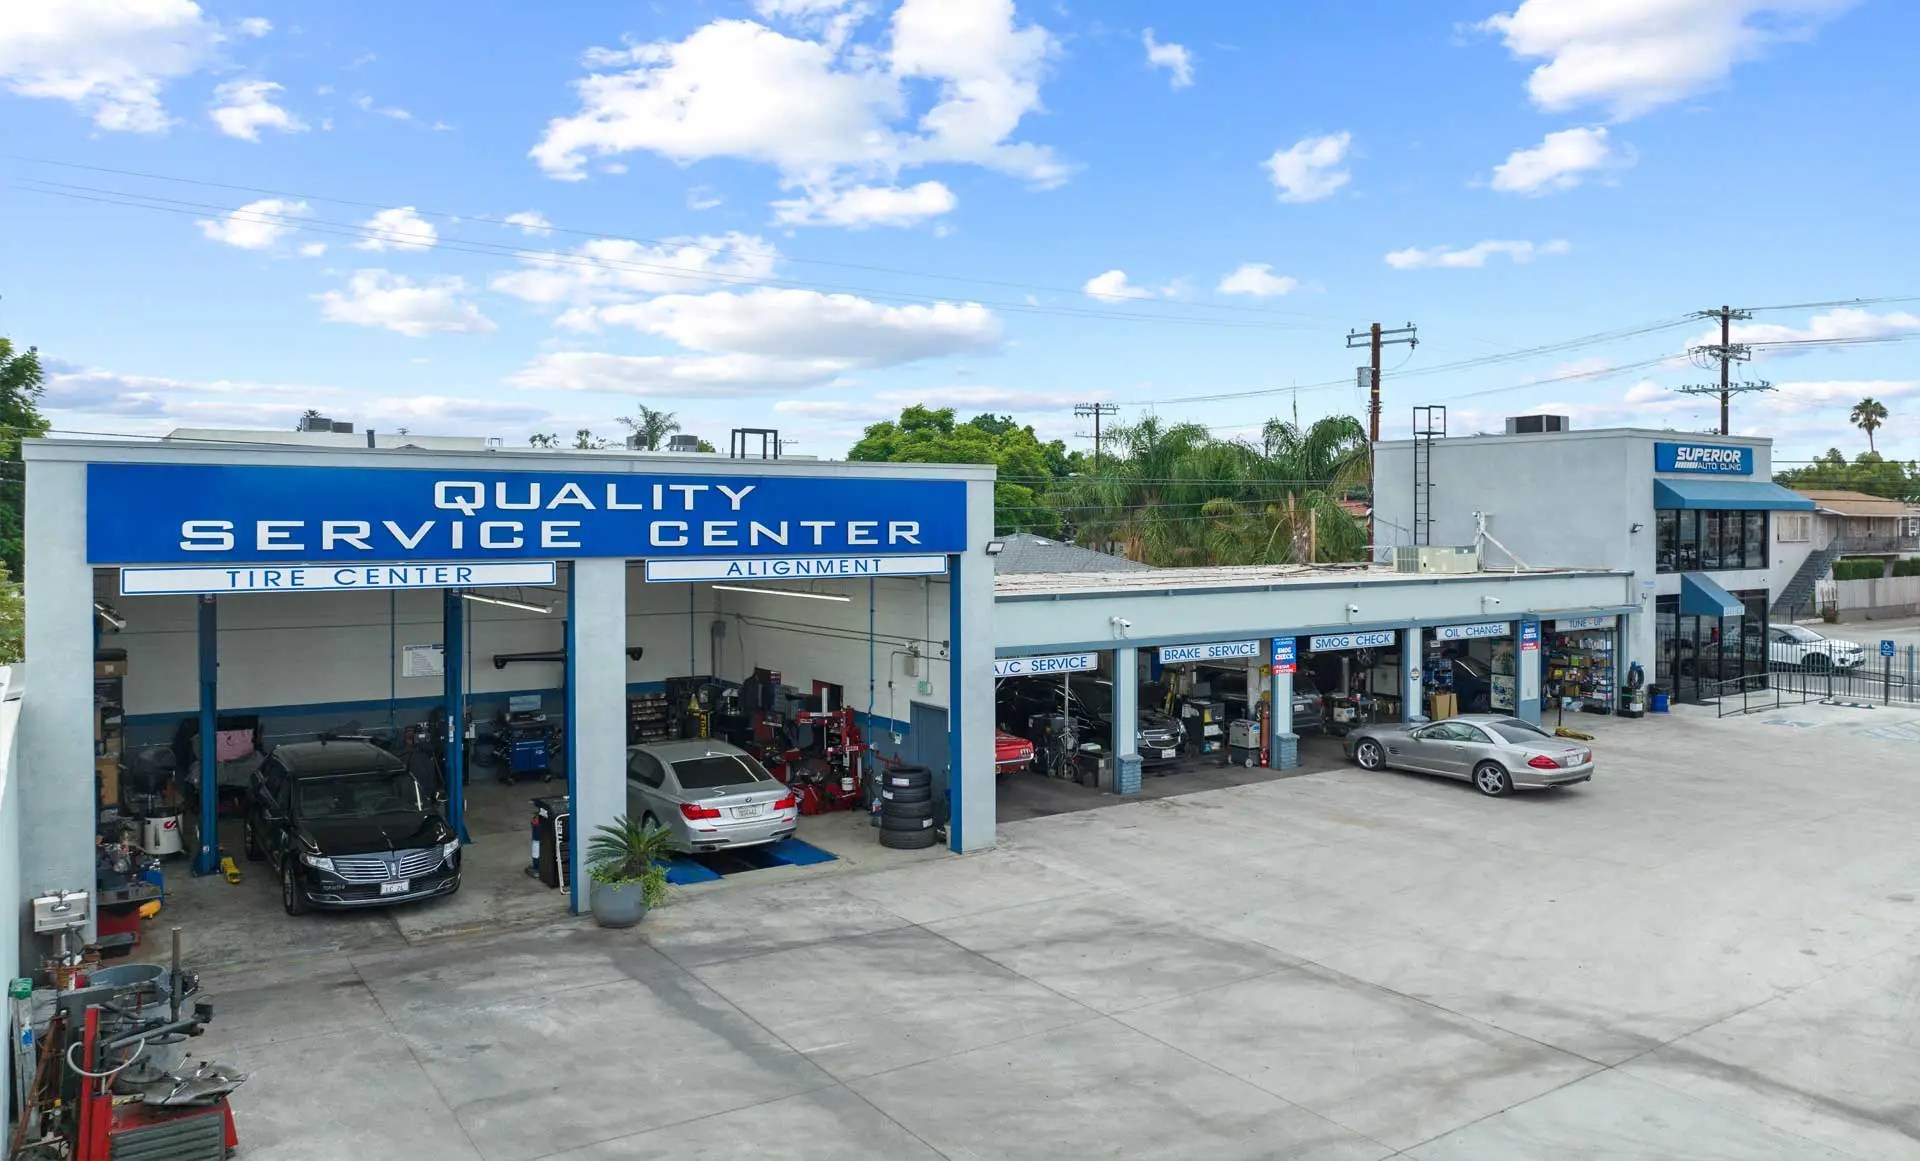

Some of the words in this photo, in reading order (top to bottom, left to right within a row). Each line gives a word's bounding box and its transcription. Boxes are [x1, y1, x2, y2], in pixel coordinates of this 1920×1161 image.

[1676, 447, 1741, 462] SUPERIOR
[1697, 462, 1717, 470] AUTO
[1720, 463, 1742, 471] CLINIC
[435, 481, 756, 516] QUALITY
[180, 520, 581, 551] SERVICE
[650, 521, 922, 546] CENTER
[727, 559, 881, 576] ALIGNMENT
[226, 570, 305, 588] TIRE
[334, 567, 472, 586] CENTER
[1445, 626, 1460, 638] OIL
[1466, 624, 1503, 636] CHANGE
[1315, 637, 1349, 649] SMOG
[1356, 634, 1390, 646] CHECK
[1164, 648, 1200, 660] BRAKE
[1208, 644, 1255, 657] SERVICE
[1031, 657, 1088, 671] SERVICE
